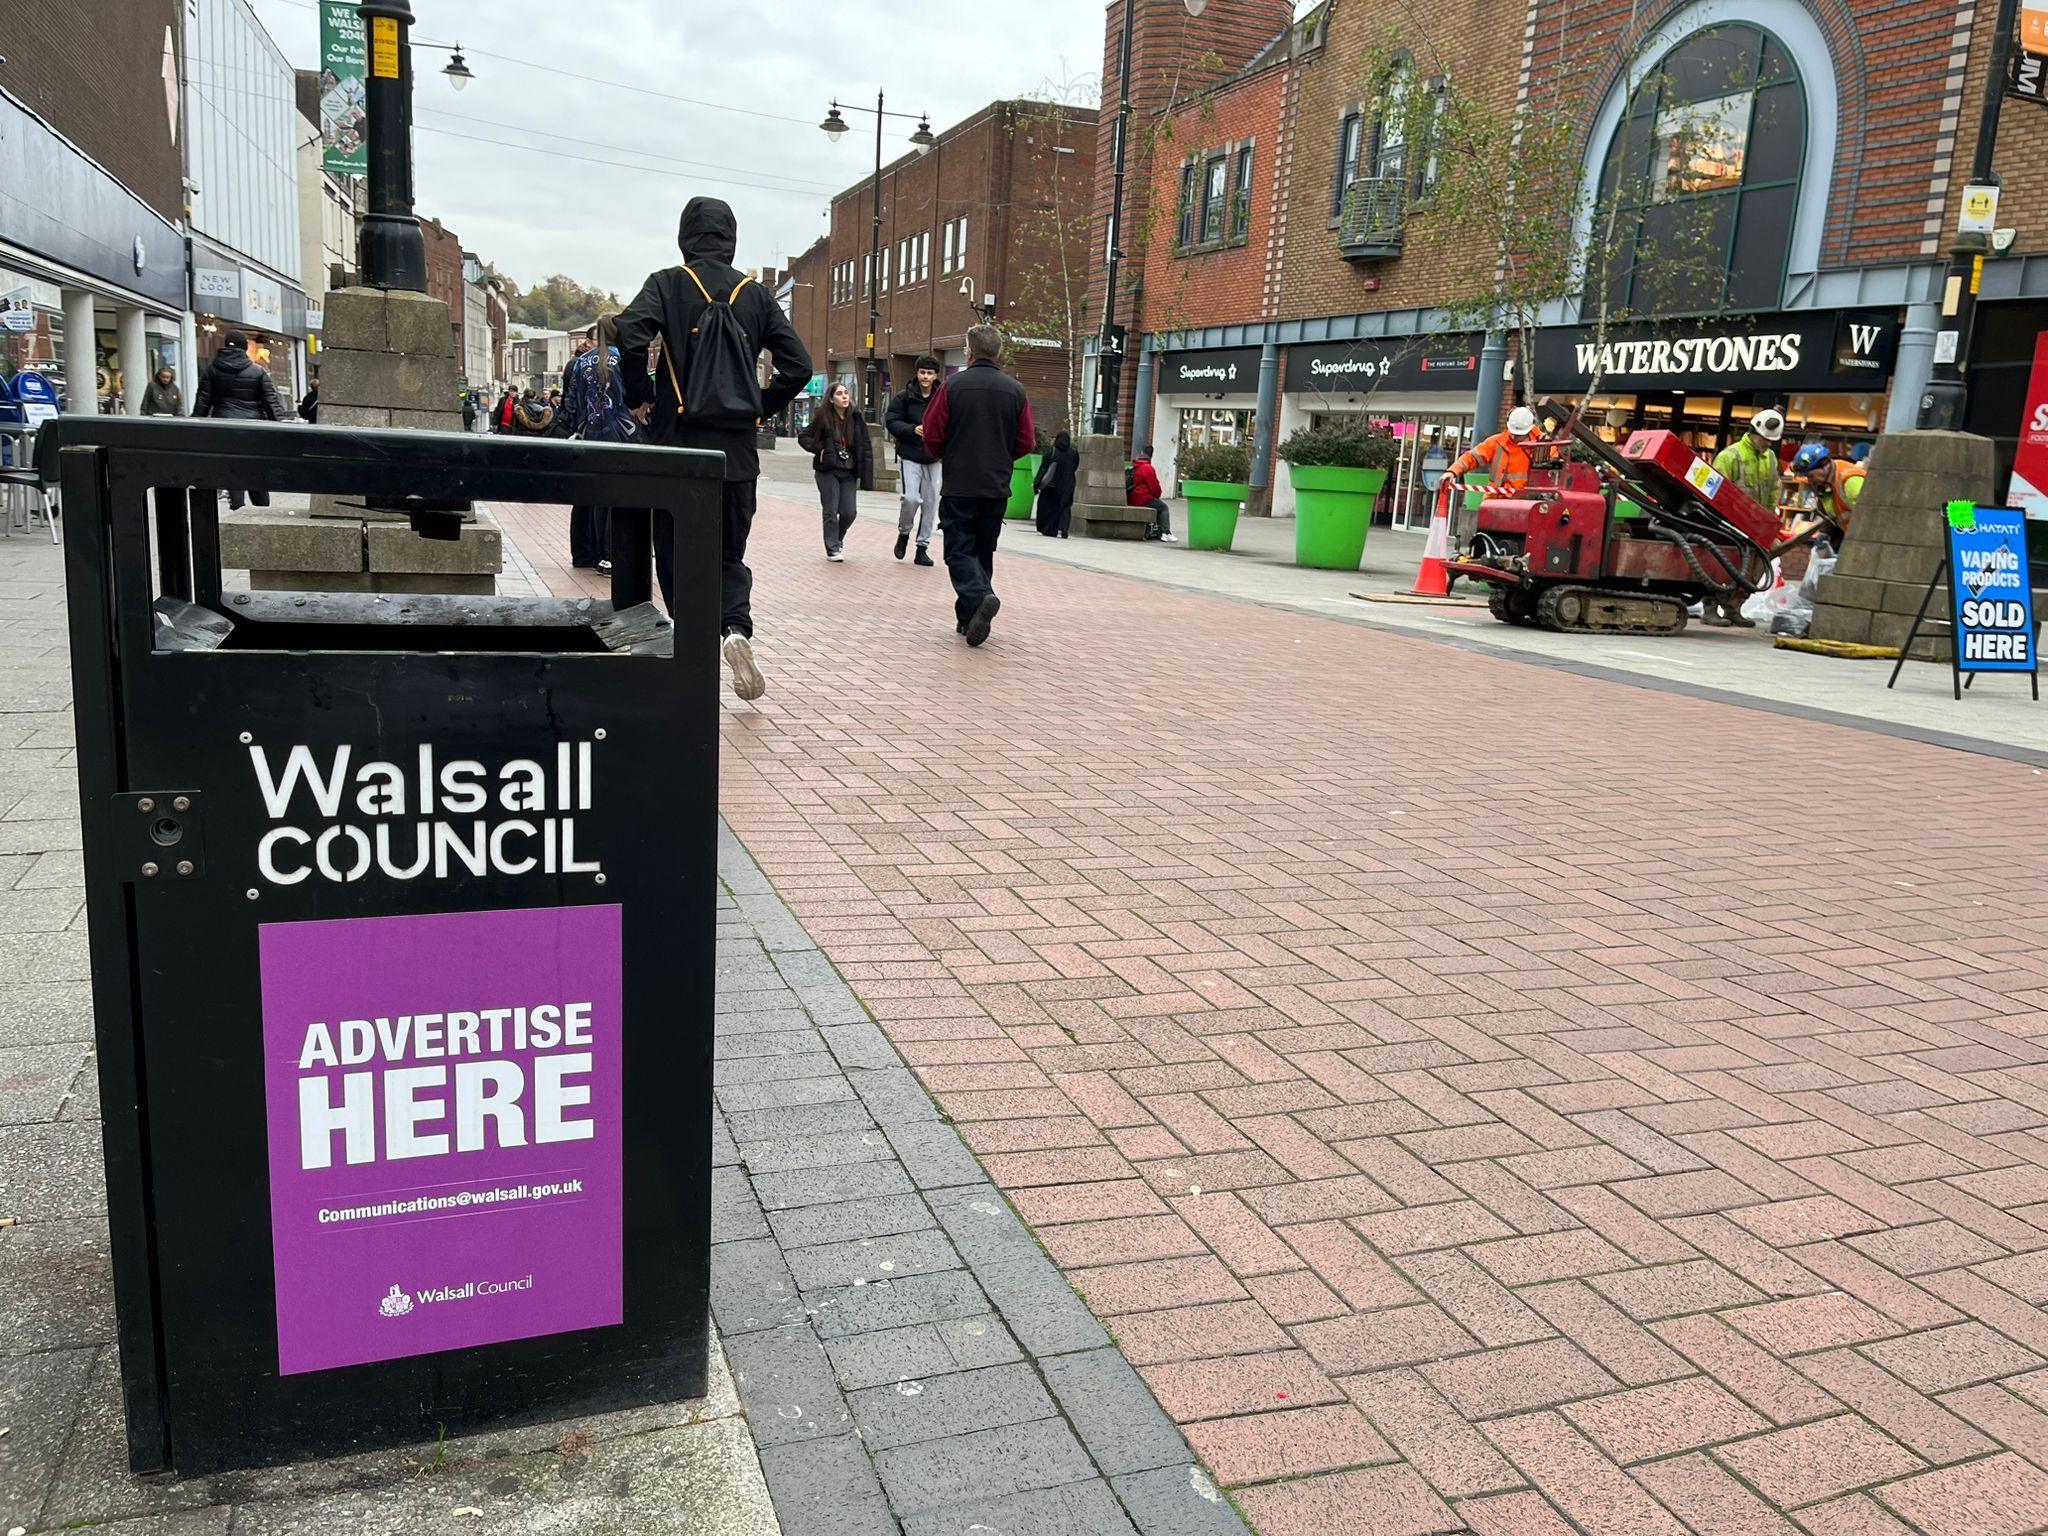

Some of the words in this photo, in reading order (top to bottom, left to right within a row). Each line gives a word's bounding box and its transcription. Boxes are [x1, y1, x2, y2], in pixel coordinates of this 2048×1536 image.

[331, 7, 350, 18] WE
[326, 53, 344, 62] Our
[331, 43, 349, 53] Our
[199, 283, 233, 293] LOOK
[201, 274, 231, 284] NEW
[1849, 324, 1881, 355] W
[1574, 333, 1801, 374] WATERSTONES
[1180, 365, 1226, 381] Superdrug
[1311, 358, 1376, 377] Superdrug
[1979, 523, 2019, 535] HAYATI
[1960, 549, 2019, 571] VAPING
[1962, 571, 2020, 587] PRODUCTS
[1962, 600, 2025, 629] SOLD
[1965, 633, 2027, 661] HERE
[249, 741, 592, 819] Walsall
[258, 817, 601, 885] COUNCIL
[298, 1002, 593, 1069] ADVERTISE
[298, 1052, 594, 1170] HERE
[318, 1179, 583, 1223] Communications@walsall.gov.uk
[417, 1282, 475, 1304] Walsall
[476, 1274, 533, 1296] Council
